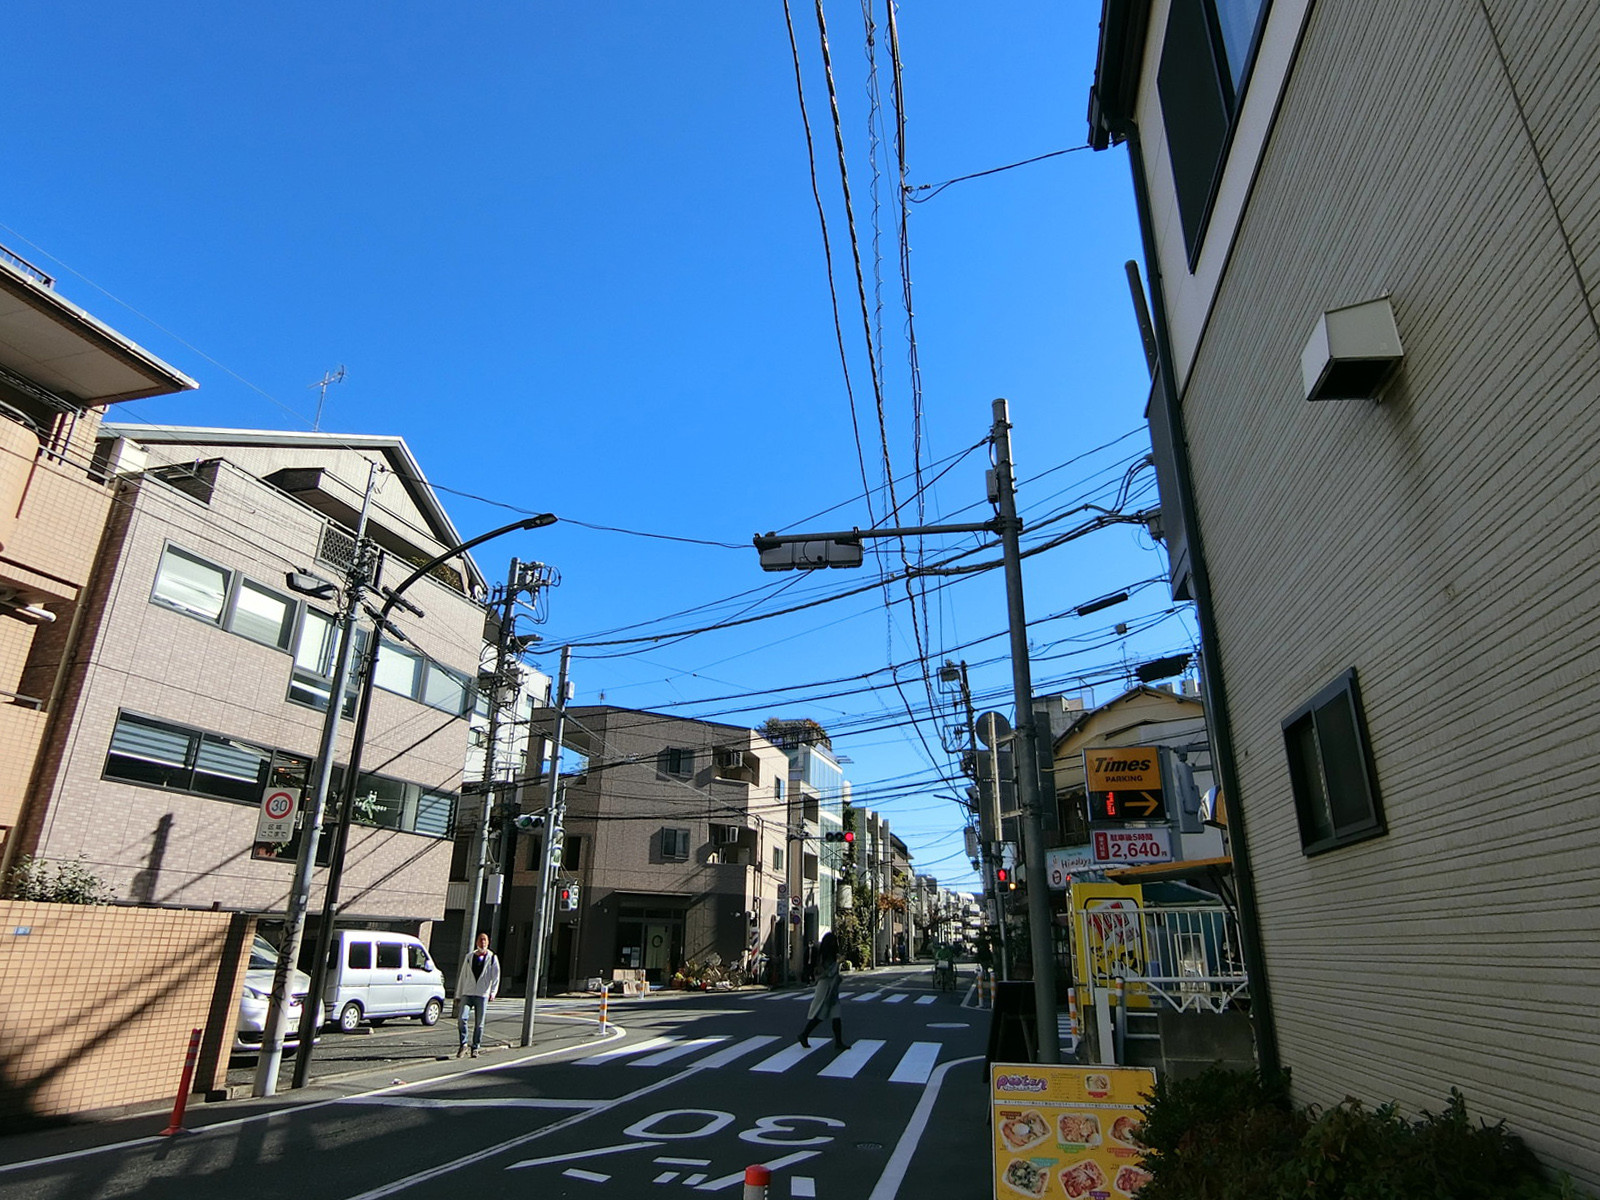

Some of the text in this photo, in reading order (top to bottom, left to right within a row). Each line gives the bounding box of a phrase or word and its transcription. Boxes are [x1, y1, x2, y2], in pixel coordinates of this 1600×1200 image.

[1095, 757, 1151, 773] Times
[1105, 774, 1143, 783] PARKING
[271, 799, 288, 812] 30
[261, 830, 287, 838] ここまで
[622, 1109, 846, 1145] 30
